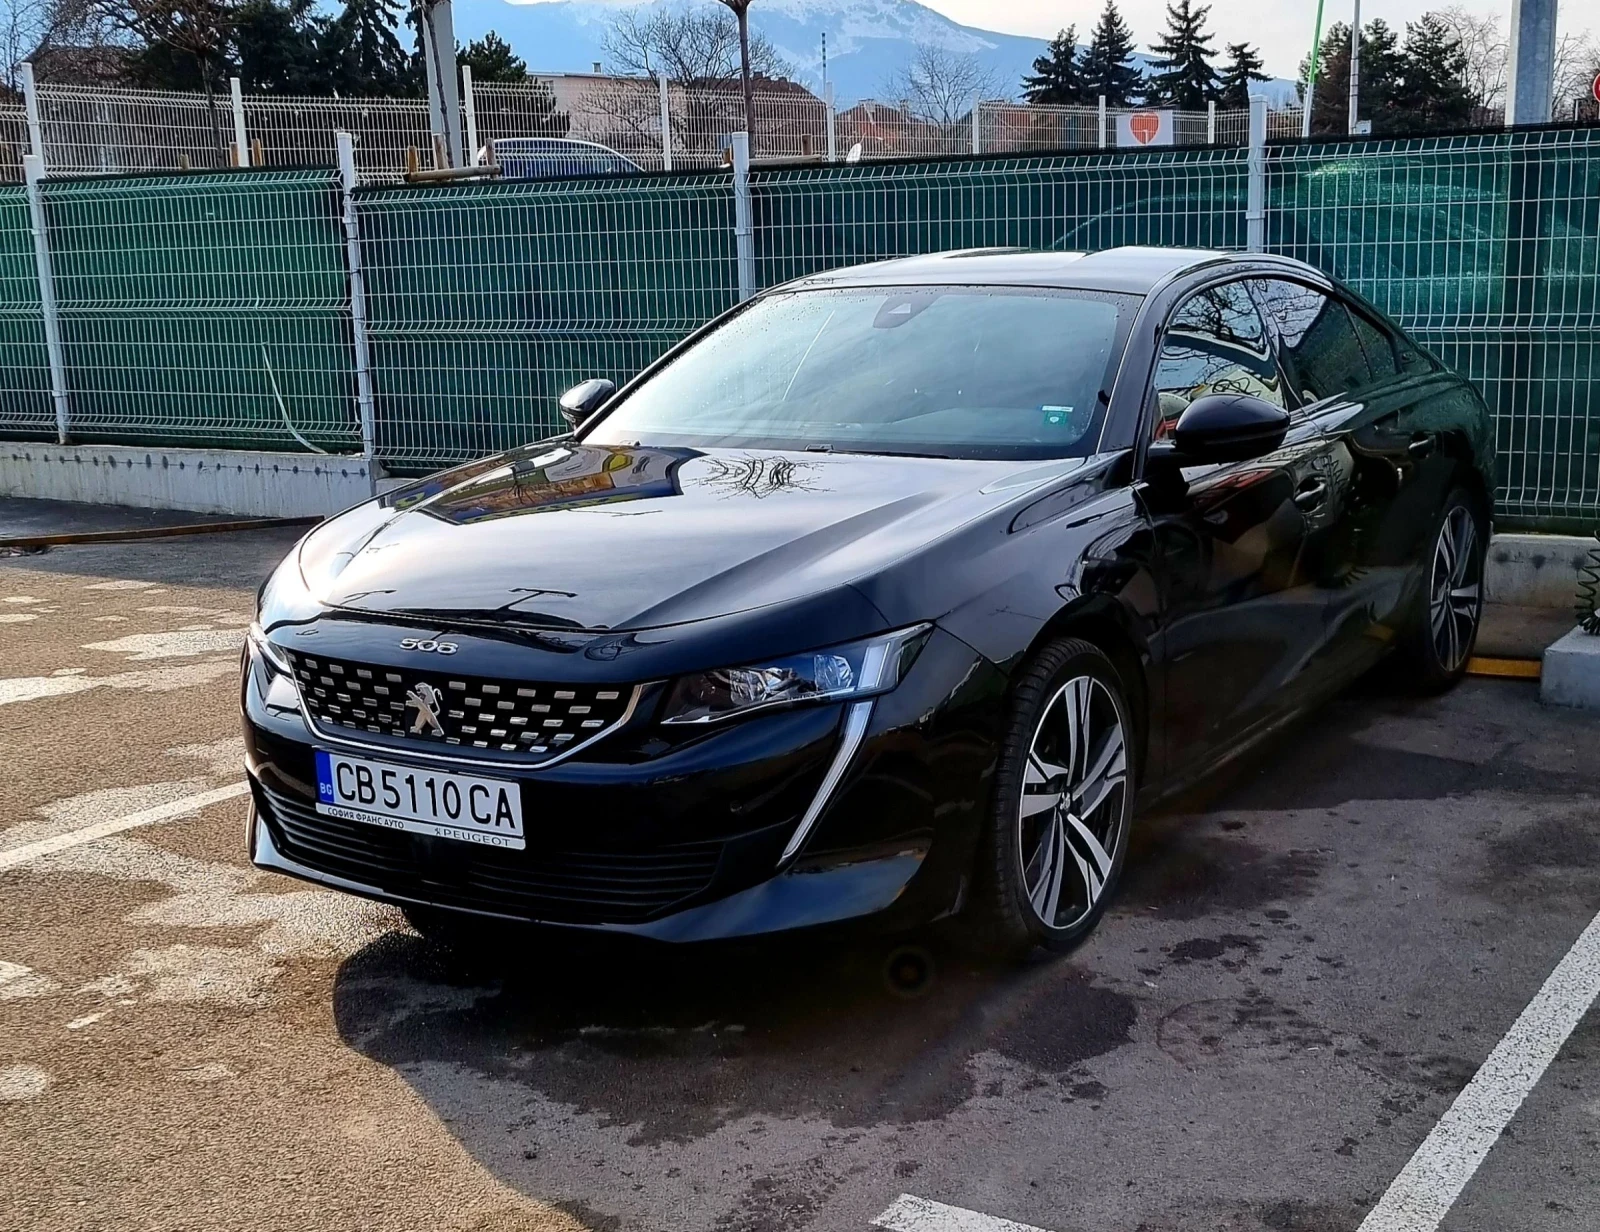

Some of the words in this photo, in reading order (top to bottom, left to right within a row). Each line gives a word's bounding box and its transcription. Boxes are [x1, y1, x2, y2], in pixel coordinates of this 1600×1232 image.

[400, 638, 458, 654] 508
[319, 782, 333, 796] BG
[327, 807, 355, 820] СОФИЯ
[355, 813, 384, 826] ФРАНС
[384, 818, 404, 829] АУТО
[443, 828, 511, 847] PEUGEOT
